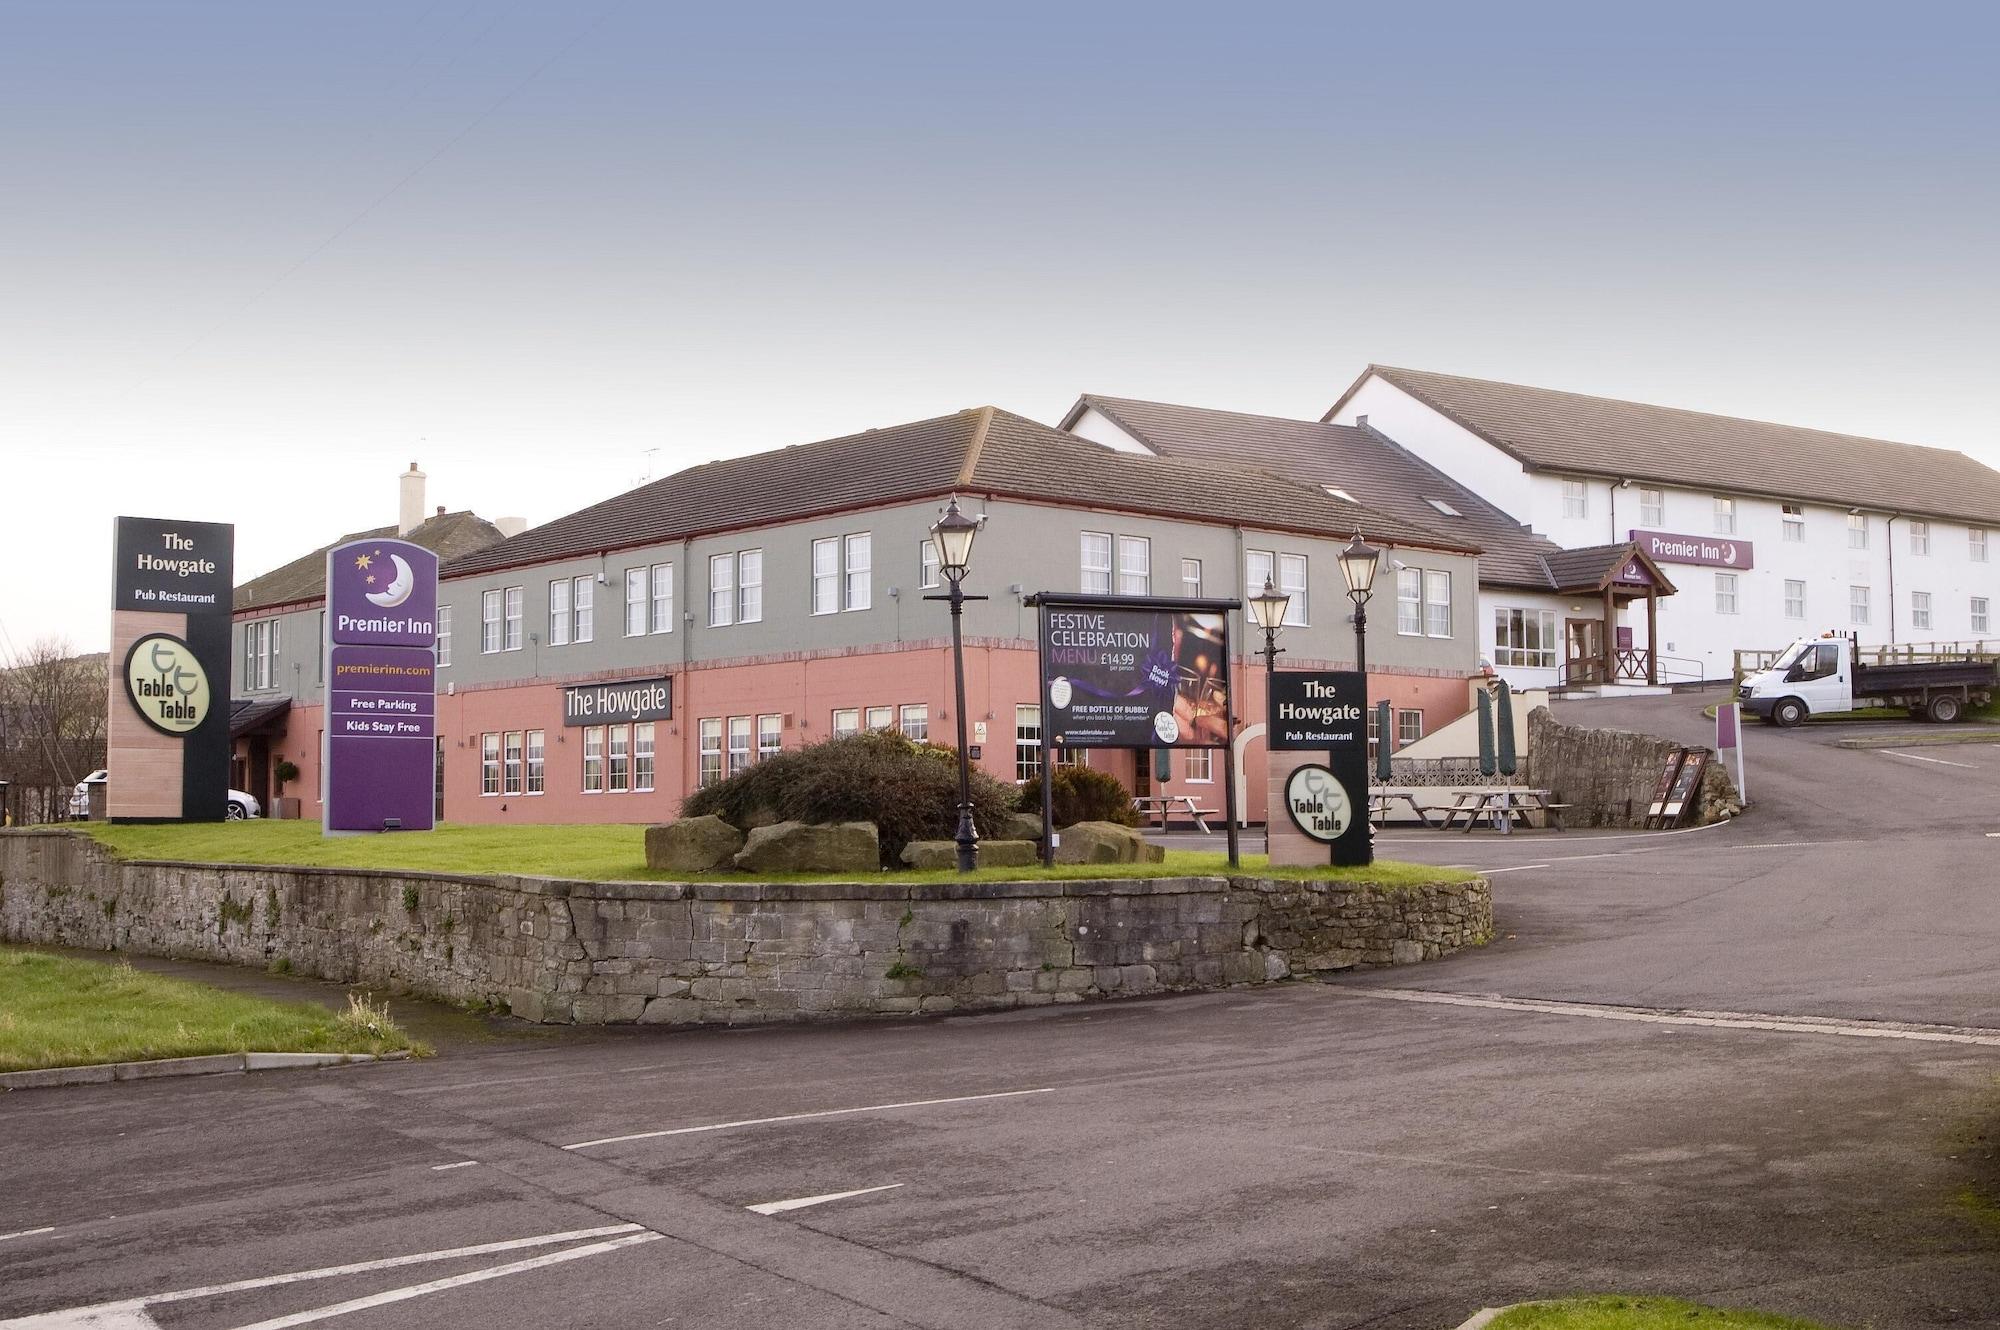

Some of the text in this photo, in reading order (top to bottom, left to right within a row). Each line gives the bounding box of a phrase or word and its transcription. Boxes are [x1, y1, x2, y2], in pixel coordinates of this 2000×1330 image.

[162, 533, 193, 550] The
[1652, 537, 1720, 560] Premier Inn
[137, 554, 215, 577] Howgate
[135, 589, 215, 603] Pub Restaurant
[338, 615, 432, 634] Premier Inn
[1050, 613, 1105, 630] FESTIVE
[1051, 631, 1149, 648] CELEBRATION
[1052, 648, 1097, 664] MENU
[1101, 653, 1134, 665] £14.99
[336, 664, 431, 675] premierinn.com
[1152, 665, 1170, 679] Book
[137, 674, 173, 697] Table
[1149, 672, 1169, 686] Now!
[1302, 681, 1336, 698] The
[159, 695, 196, 719] Table
[351, 699, 417, 712] Free Parking
[566, 683, 666, 719] The Howgate
[1072, 705, 1087, 713] FREE
[1089, 705, 1113, 713] BOTTLE
[1124, 706, 1149, 714] BUBBLY
[1279, 703, 1360, 725] Howgate
[346, 720, 420, 734] Kids Stay Free
[1285, 731, 1353, 741] Pub Restaurant
[1293, 794, 1324, 813] Table
[1311, 812, 1341, 831] Table
